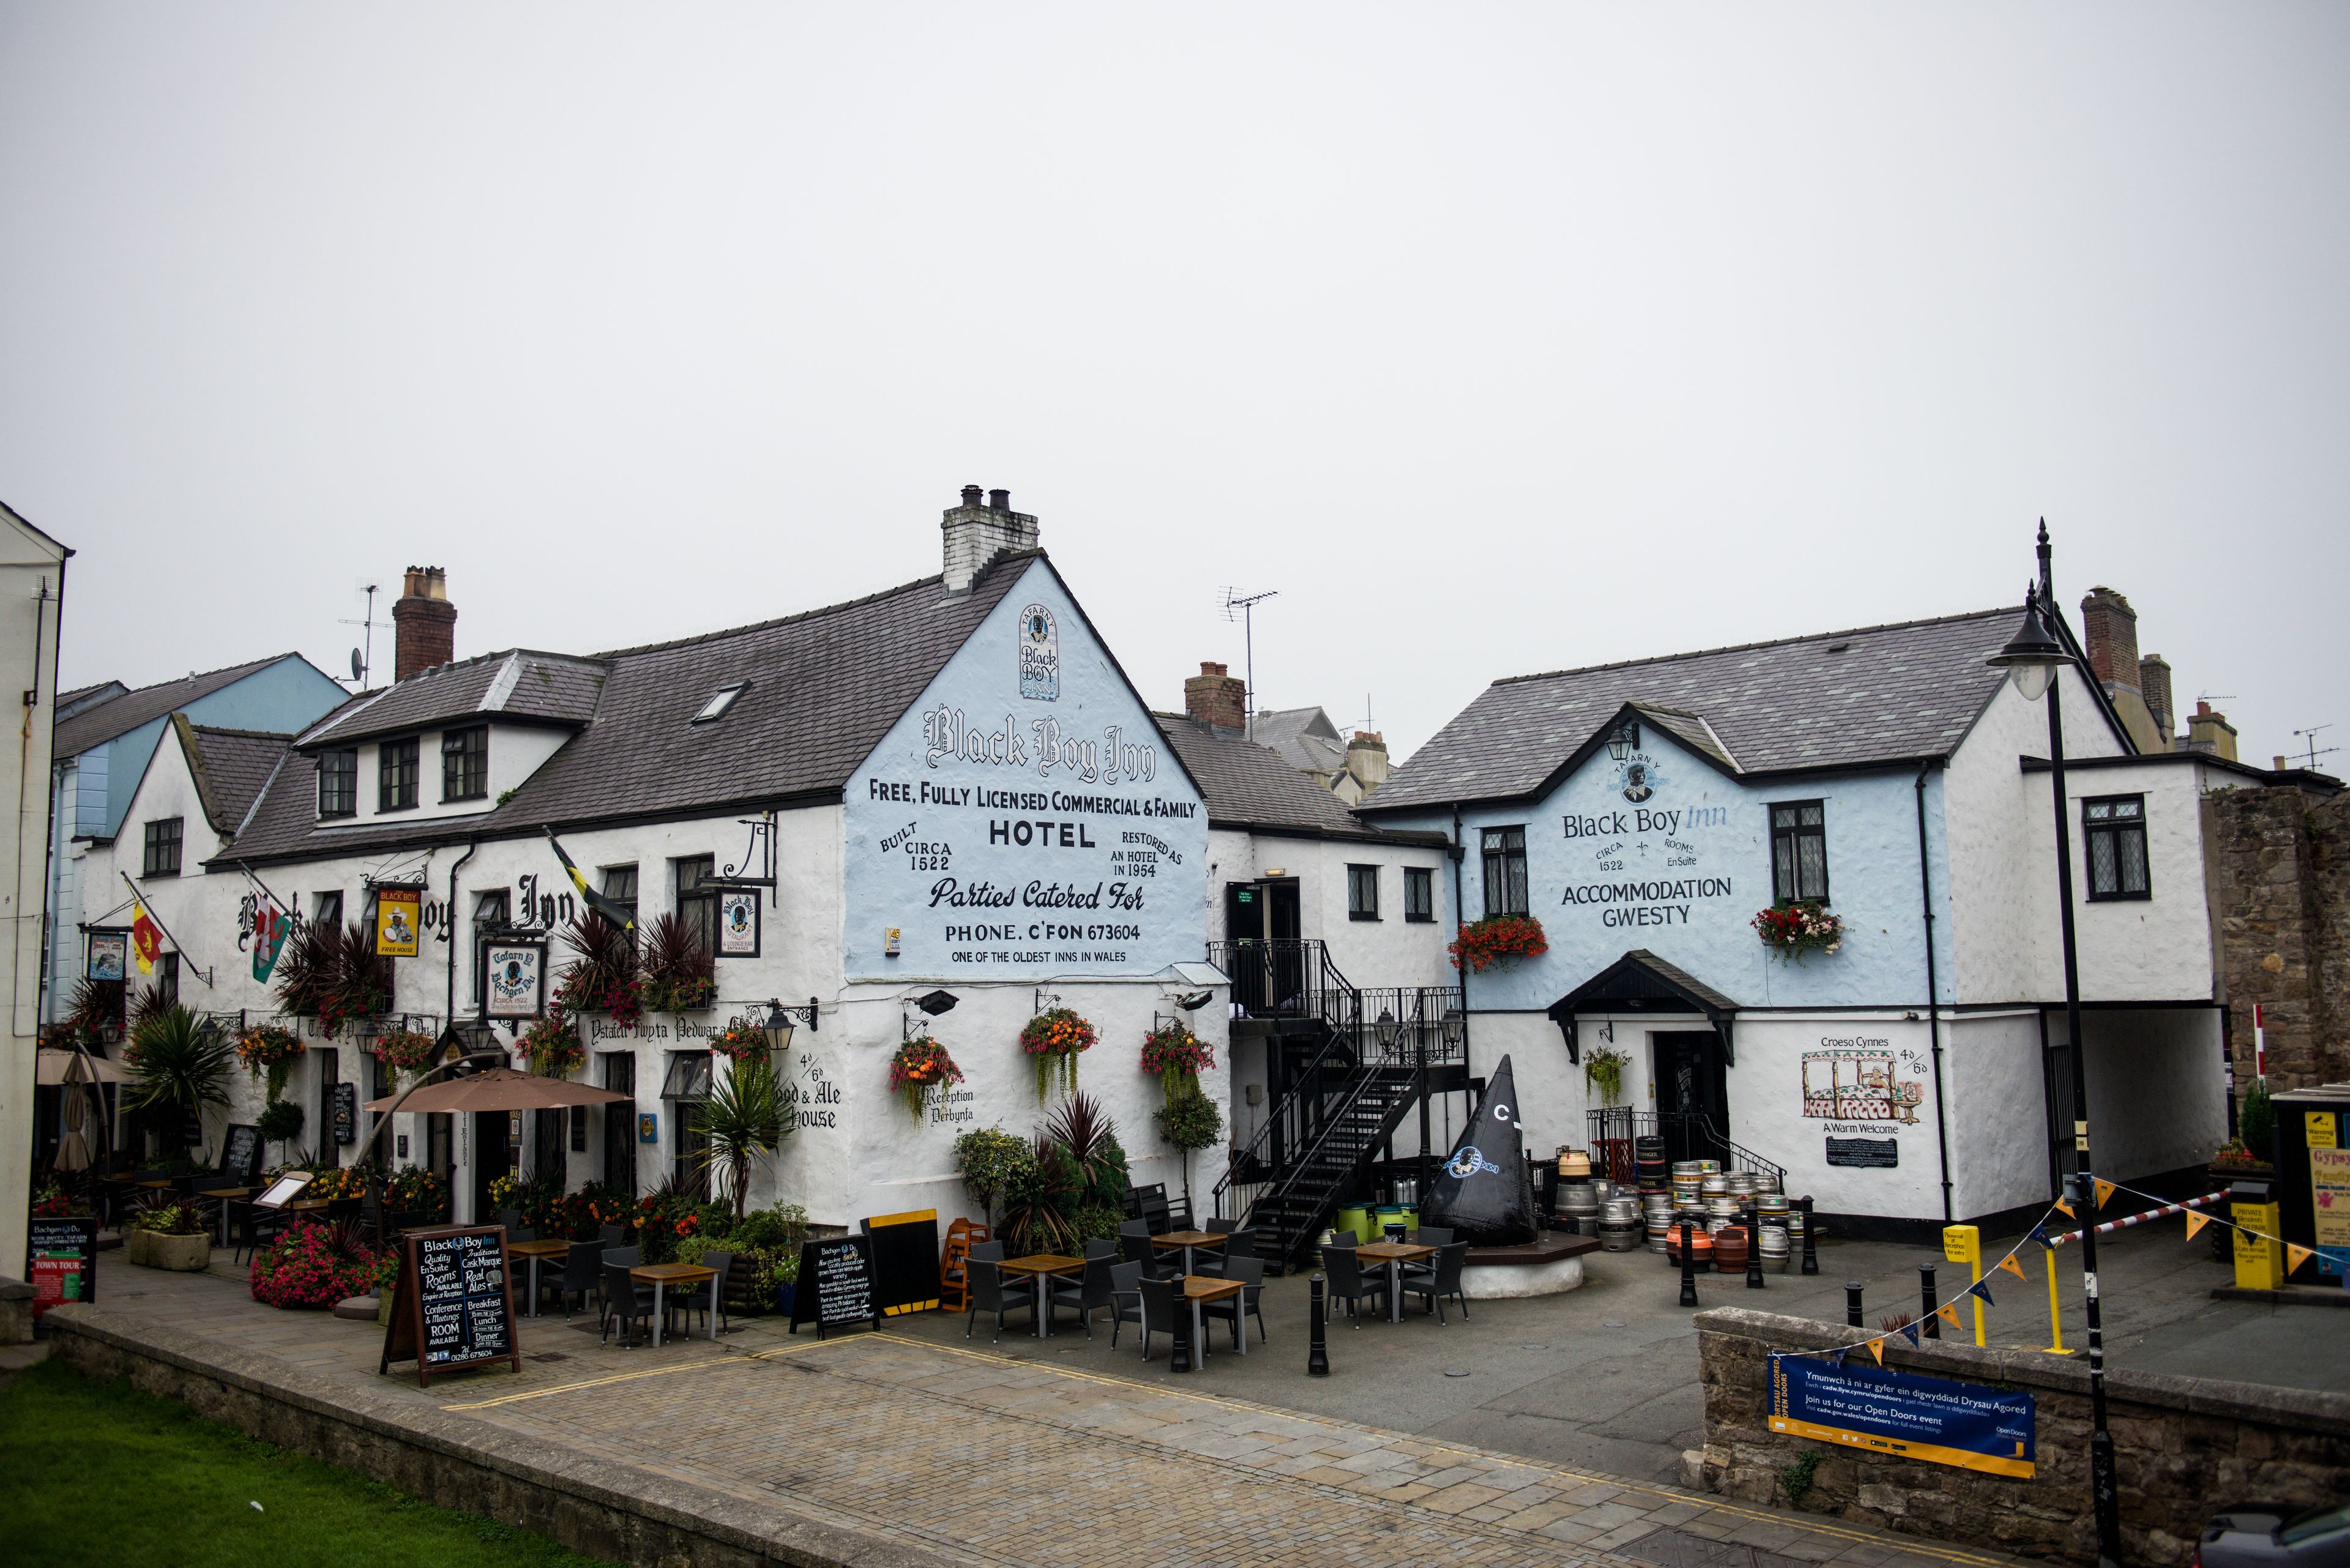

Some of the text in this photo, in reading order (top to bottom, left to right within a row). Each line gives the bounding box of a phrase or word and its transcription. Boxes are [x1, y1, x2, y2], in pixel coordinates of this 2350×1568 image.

[1021, 645, 1058, 668] Black
[1030, 682, 1051, 695] INN
[923, 703, 1156, 786] Black Boy Inn
[1614, 753, 1662, 774] TAFARN Y
[1143, 802, 1153, 817] &
[1562, 805, 1727, 838] Black Boy Inn
[879, 821, 918, 853] BUILT
[990, 819, 1096, 848] HOTEL
[905, 842, 952, 856] CIRCA
[1122, 831, 1183, 865] RESTORED AS
[1595, 842, 1624, 861] CIRCA
[1664, 838, 1695, 854] ROOMS
[910, 856, 950, 872] 1522
[1110, 851, 1158, 864] AN HOTEL
[1667, 855, 1697, 867] En Suite
[1114, 864, 1156, 878] IN 1954
[1600, 859, 1624, 872] 1522
[928, 877, 1145, 911] Parties Catered For
[1561, 876, 1731, 906] ACCOMMODATION
[723, 895, 755, 917] Black Boy
[1602, 905, 1690, 927] GWESTY
[724, 924, 753, 941] RESTAURANT
[945, 920, 1141, 943] PHONE. C'FON 673604
[493, 950, 523, 964] Tafarn
[951, 951, 1126, 963] ONE OF THE OLDEST INNS IN WALES
[491, 971, 535, 999] Bachgen Du
[674, 1016, 717, 1042] Pedwar
[1821, 1037, 1889, 1048] Croeso Cynnes
[802, 1081, 841, 1104] & Ale
[1493, 1103, 1510, 1121] C
[1823, 1123, 1899, 1134] A Warm Welcome
[424, 1235, 495, 1252] Black Boy Inn
[425, 1254, 451, 1265] Quality
[467, 1248, 499, 1258] Traditional
[59, 1261, 80, 1270] TOUR
[420, 1264, 449, 1274] En Suite
[461, 1256, 502, 1268] Cask Marque
[425, 1271, 457, 1289] Rooms
[465, 1268, 485, 1284] Real
[436, 1282, 463, 1291] AVAILABLE
[468, 1282, 487, 1294] Ales
[422, 1290, 463, 1302] Enquire Reception
[468, 1297, 501, 1310] Breakfast
[425, 1303, 463, 1315] Conference
[432, 1313, 460, 1323] Meetings
[474, 1316, 496, 1326] Lunch
[431, 1323, 460, 1337] ROOM
[475, 1332, 499, 1342] Dinner
[429, 1335, 459, 1346] AVAILABLE
[451, 1350, 493, 1362] 01286 673604
[1806, 1371, 1845, 1385] Ymunwch
[1854, 1379, 1862, 1387] ni
[1874, 1383, 1895, 1394] gyfer
[1912, 1389, 1958, 1404] digwyddiad
[1961, 1397, 1991, 1409] Drysau
[1993, 1402, 2026, 1414] Agored
[1822, 1385, 1902, 1403] cadw.llyw.cymru/opendoors
[1805, 1394, 1820, 1405] Join
[1833, 1399, 1846, 1408] for
[1865, 1405, 1888, 1417] Open
[1890, 1408, 1917, 1421] Doors
[1919, 1415, 1942, 1425] event
[1816, 1407, 1891, 1425] cadw.gov.wales/opendoors
[1924, 1425, 1942, 1435] listings
[2010, 1428, 2027, 1437] Doors
